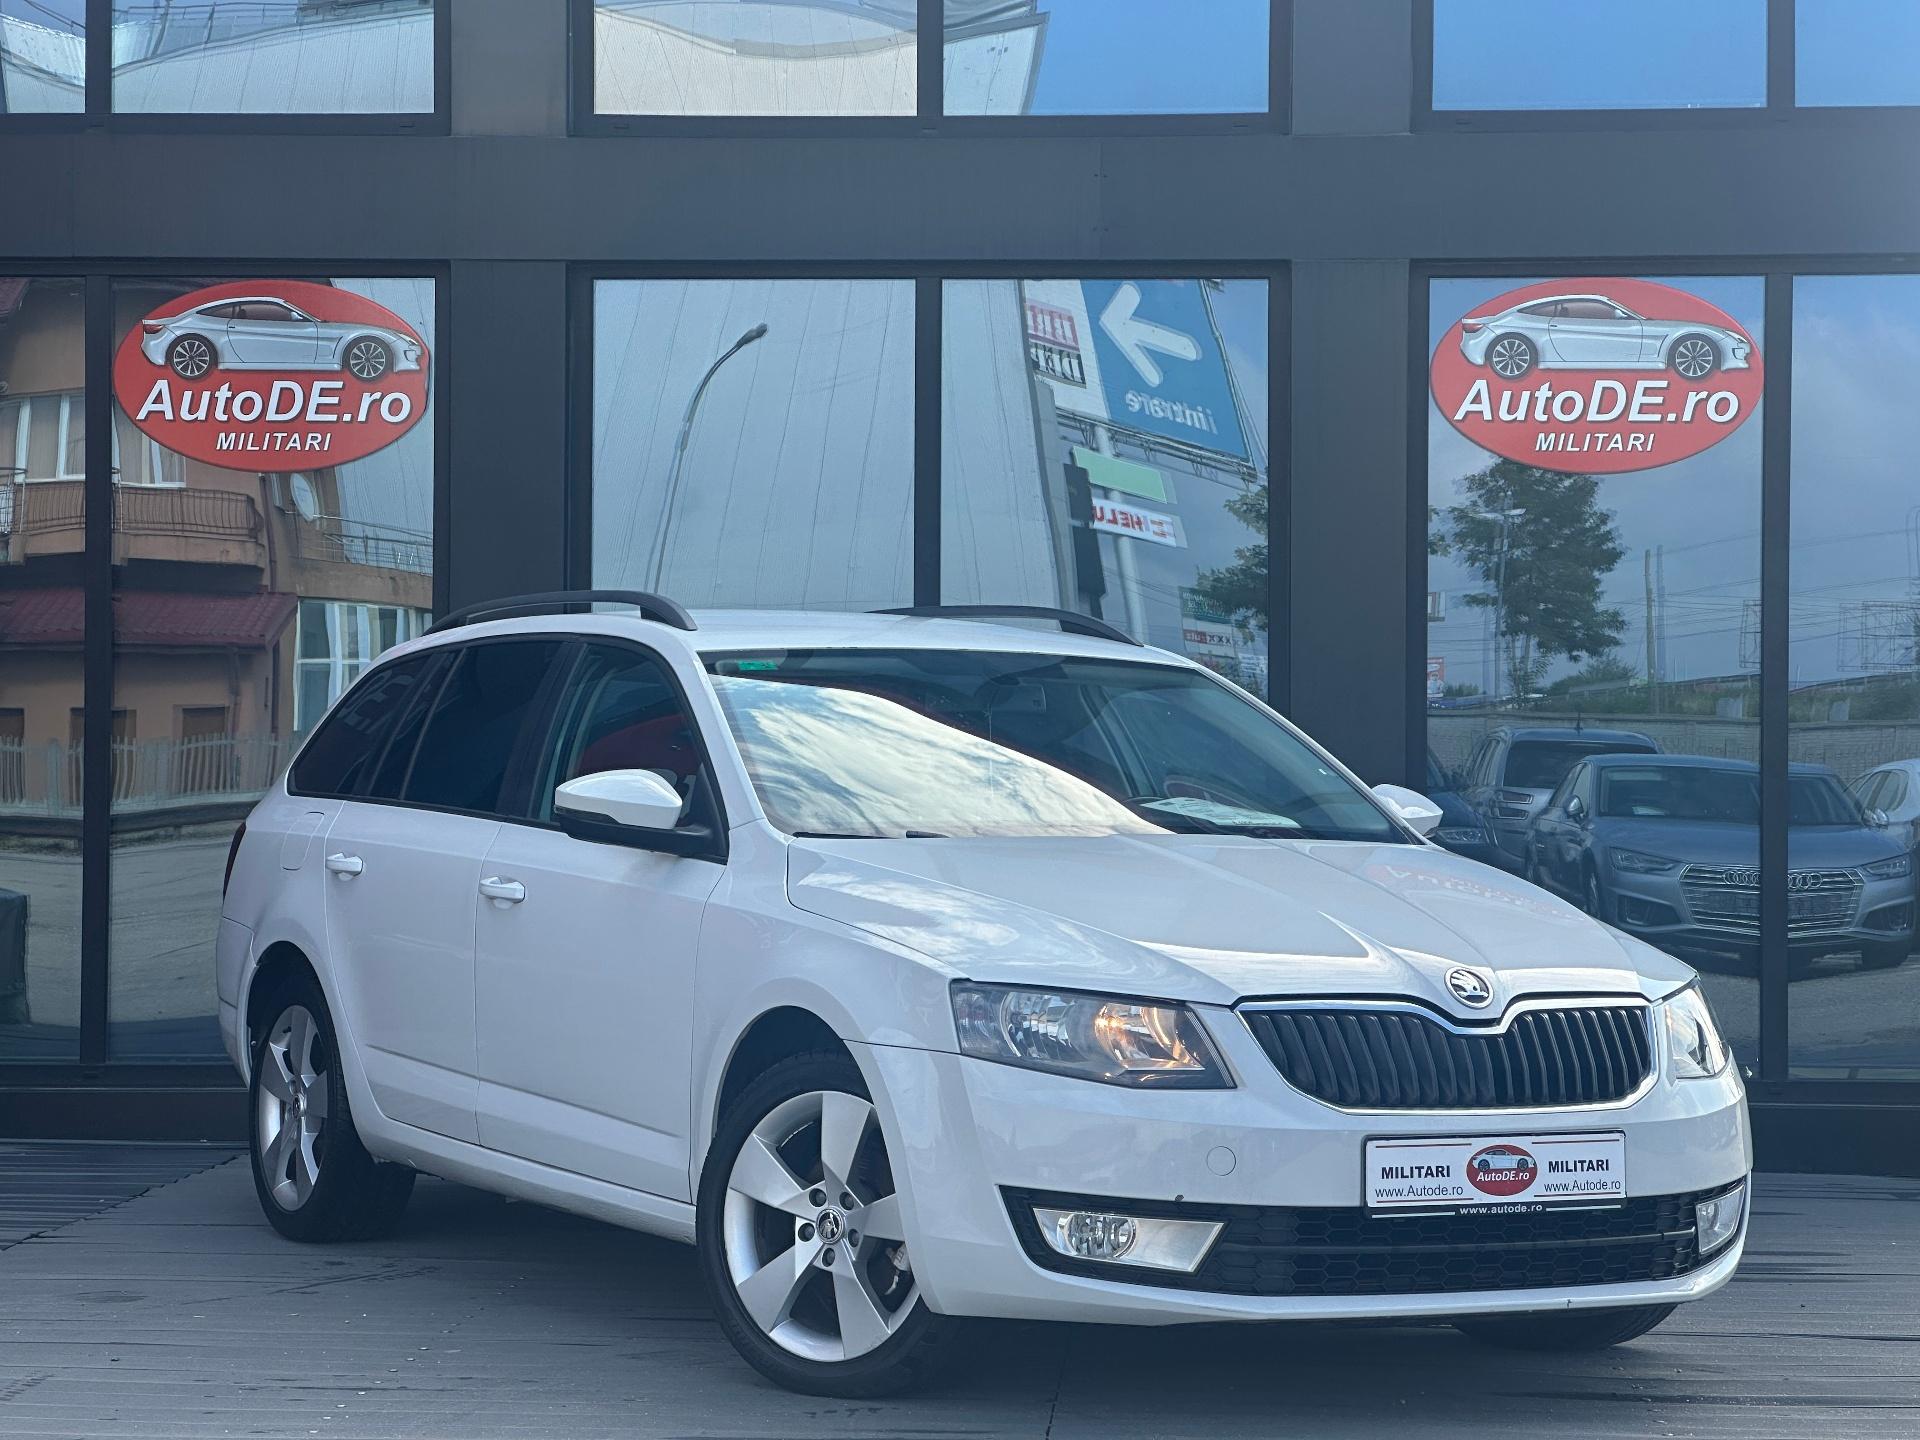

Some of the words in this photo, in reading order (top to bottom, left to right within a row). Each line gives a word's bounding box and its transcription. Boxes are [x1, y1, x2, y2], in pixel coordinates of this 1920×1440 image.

[135, 379, 412, 423] AutoDE.ro
[1453, 379, 1740, 423] AutoDE.ro
[216, 432, 332, 451] MILITARI
[1535, 432, 1655, 452] MILITARI
[1381, 1164, 1451, 1180] MILITARI
[1548, 1158, 1610, 1174] MILITARI
[1476, 1169, 1530, 1183] AutoDE.ro
[1375, 1184, 1464, 1199] www.Autode.ro
[1543, 1178, 1621, 1193] www.Autode.ro
[1459, 1202, 1543, 1216] www.autode.ro
